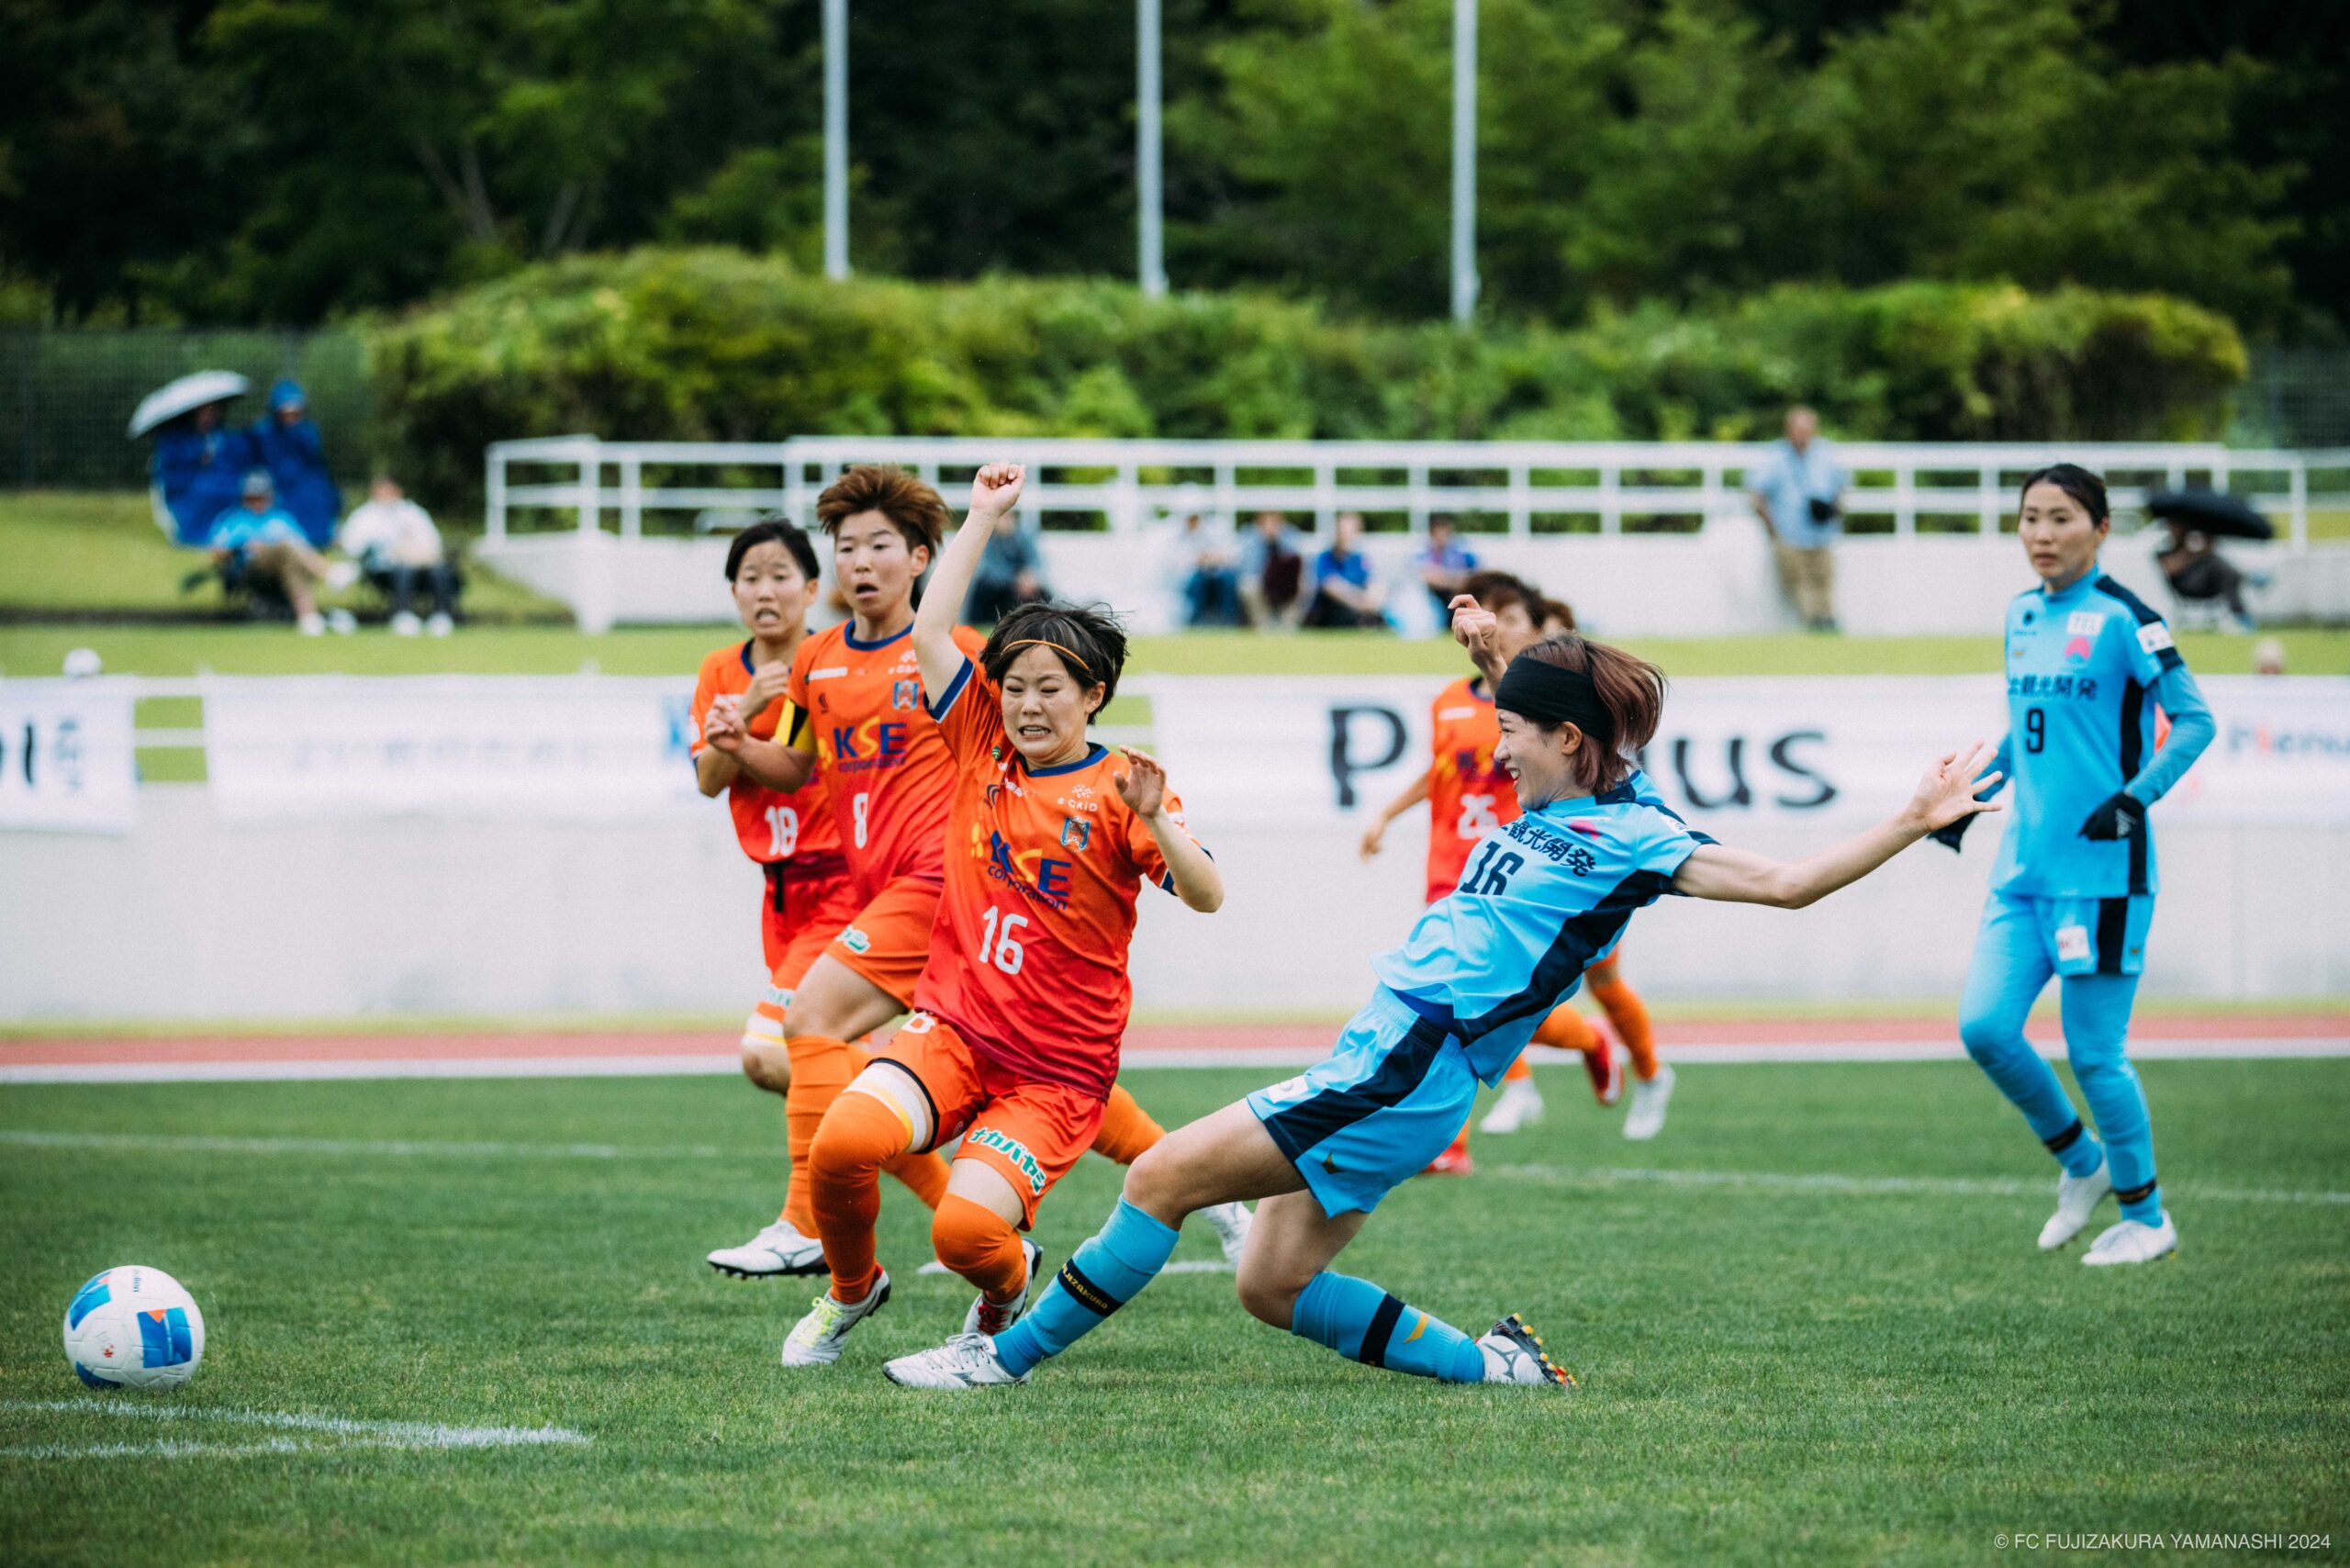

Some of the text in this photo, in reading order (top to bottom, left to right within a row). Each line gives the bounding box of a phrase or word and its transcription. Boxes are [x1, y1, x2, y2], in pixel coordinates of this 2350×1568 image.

[833, 716, 907, 759] KSE
[2026, 708, 2044, 754] 9
[765, 805, 799, 857] 18
[853, 792, 869, 850] 8
[1500, 819, 1597, 878] 観光開発
[990, 829, 1072, 897] KSE
[1459, 840, 1526, 896] 16
[979, 904, 1029, 975] 16
[968, 1127, 1046, 1194] ナカバヤシ
